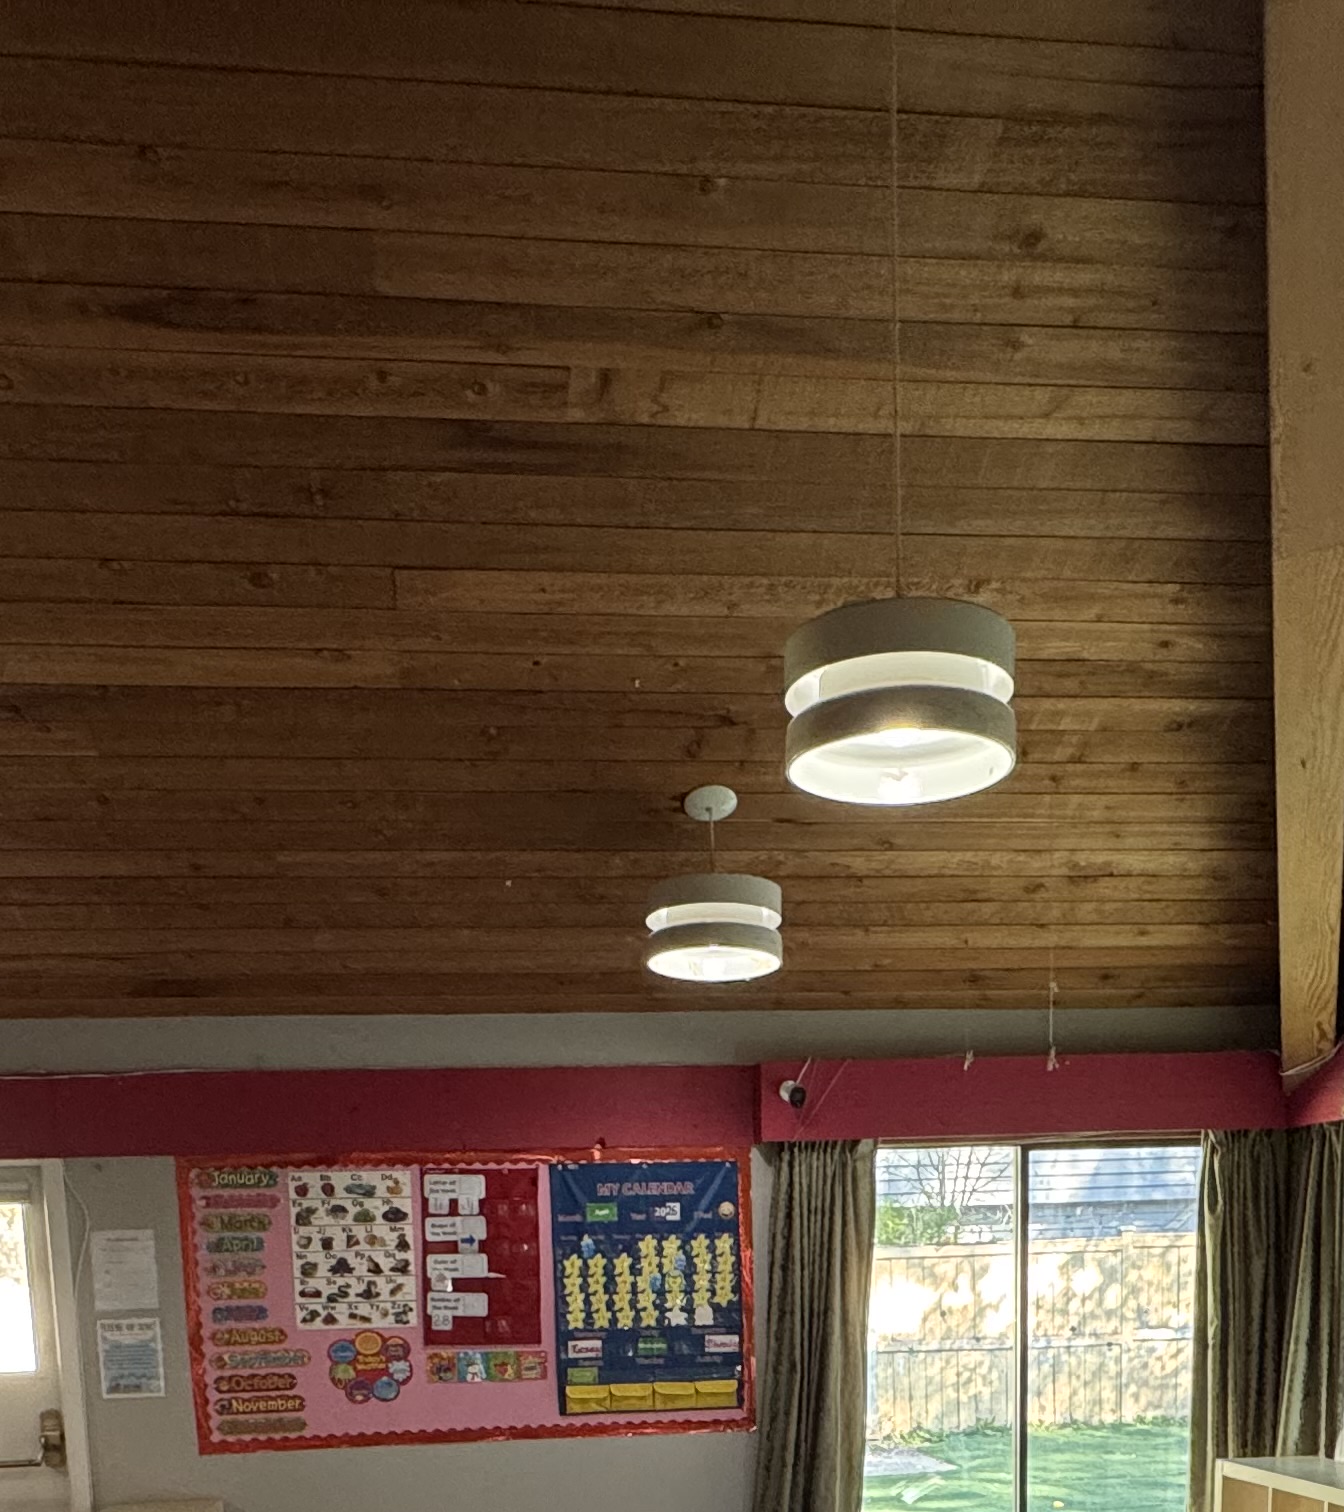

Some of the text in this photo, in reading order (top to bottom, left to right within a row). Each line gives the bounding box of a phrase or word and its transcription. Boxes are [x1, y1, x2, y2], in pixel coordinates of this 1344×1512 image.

[212, 1170, 270, 1185] January
[597, 1180, 695, 1196] MY CALENDAR
[221, 1238, 258, 1251] April
[229, 1328, 280, 1343] August
[232, 1374, 292, 1390] October
[232, 1397, 301, 1413] November
